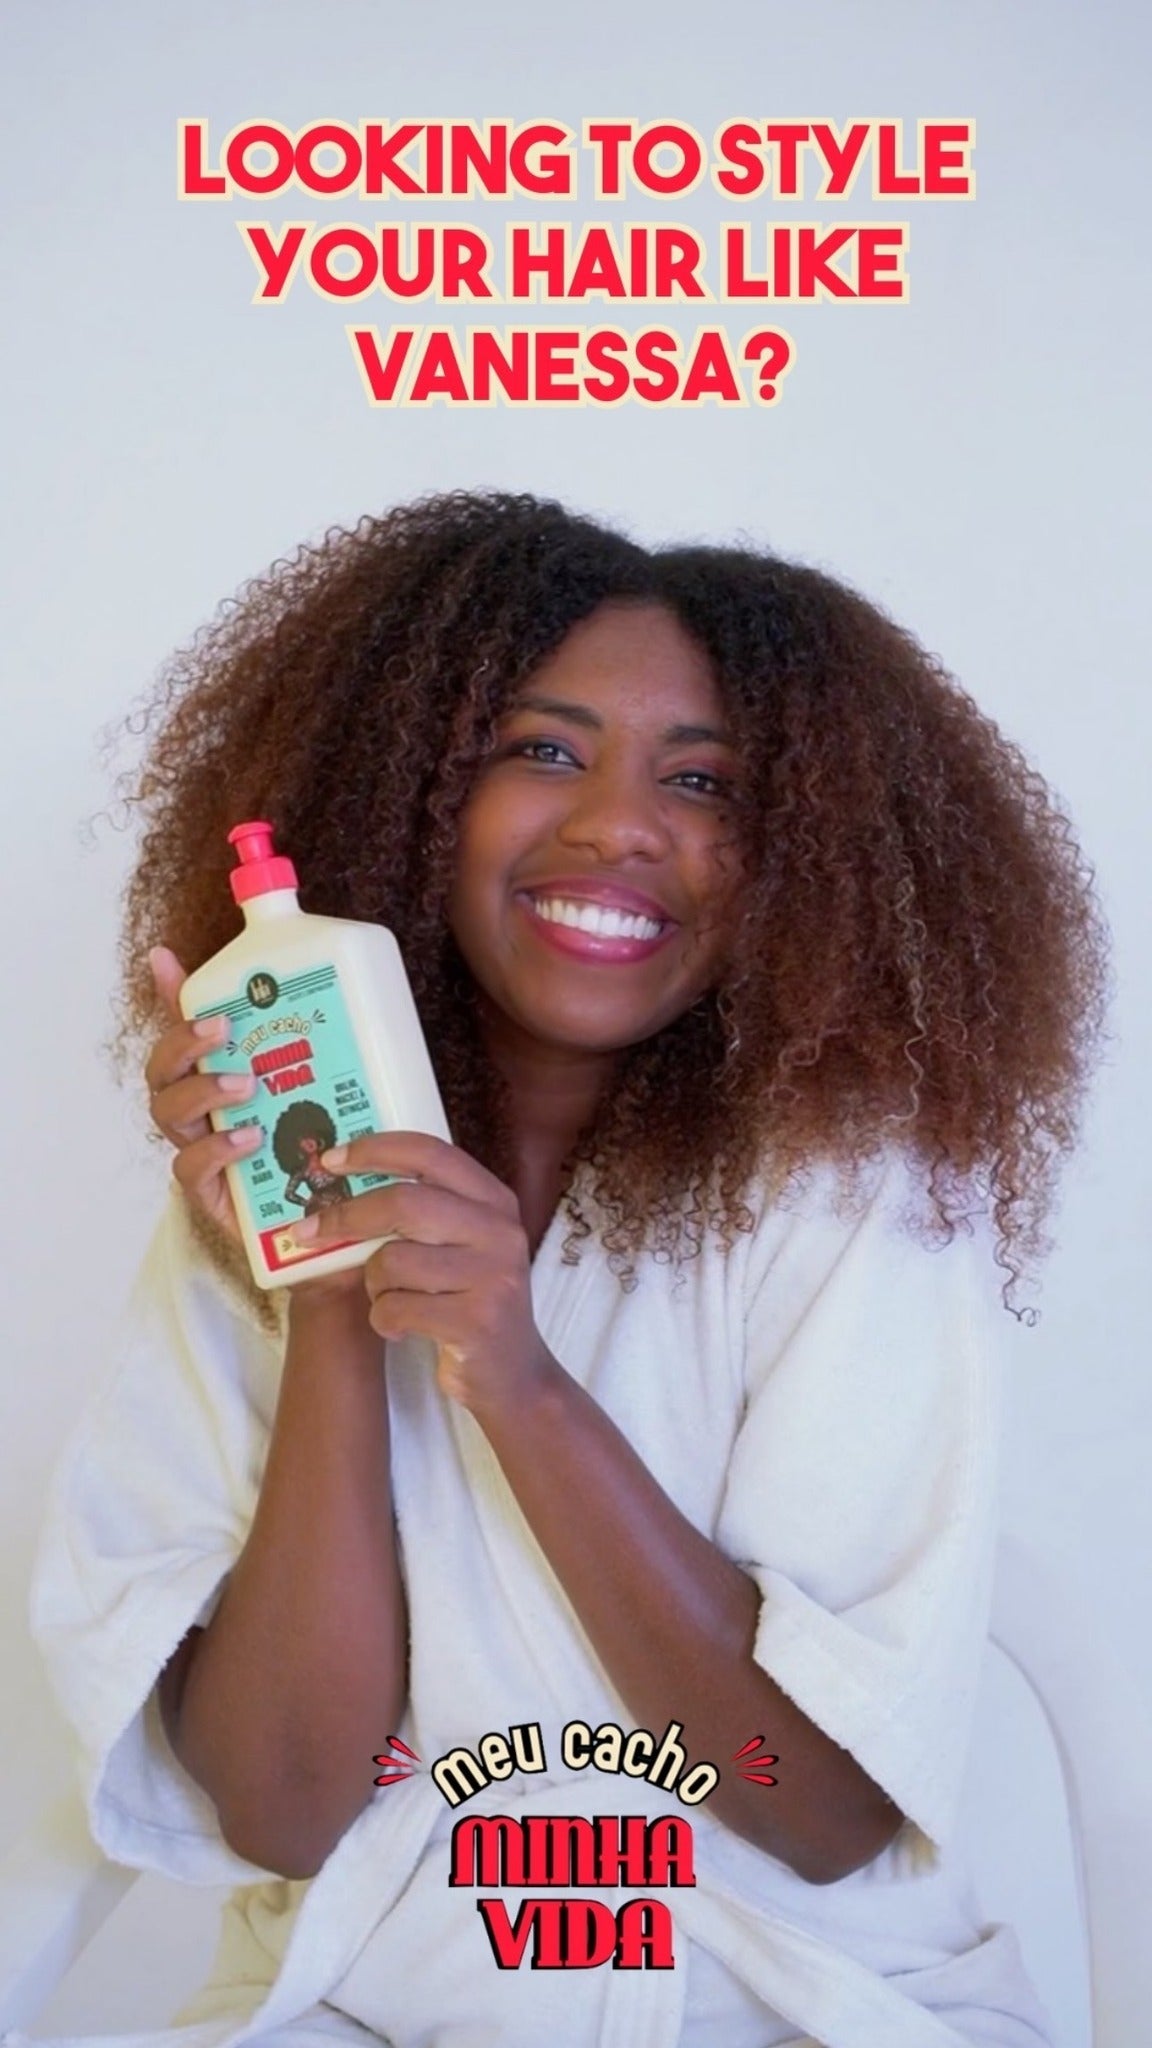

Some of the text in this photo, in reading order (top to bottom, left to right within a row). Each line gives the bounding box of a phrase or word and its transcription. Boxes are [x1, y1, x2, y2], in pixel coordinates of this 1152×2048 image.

[241, 1025, 269, 1055] meu
[270, 1012, 312, 1036] cacho
[262, 1064, 316, 1097] VIDA
